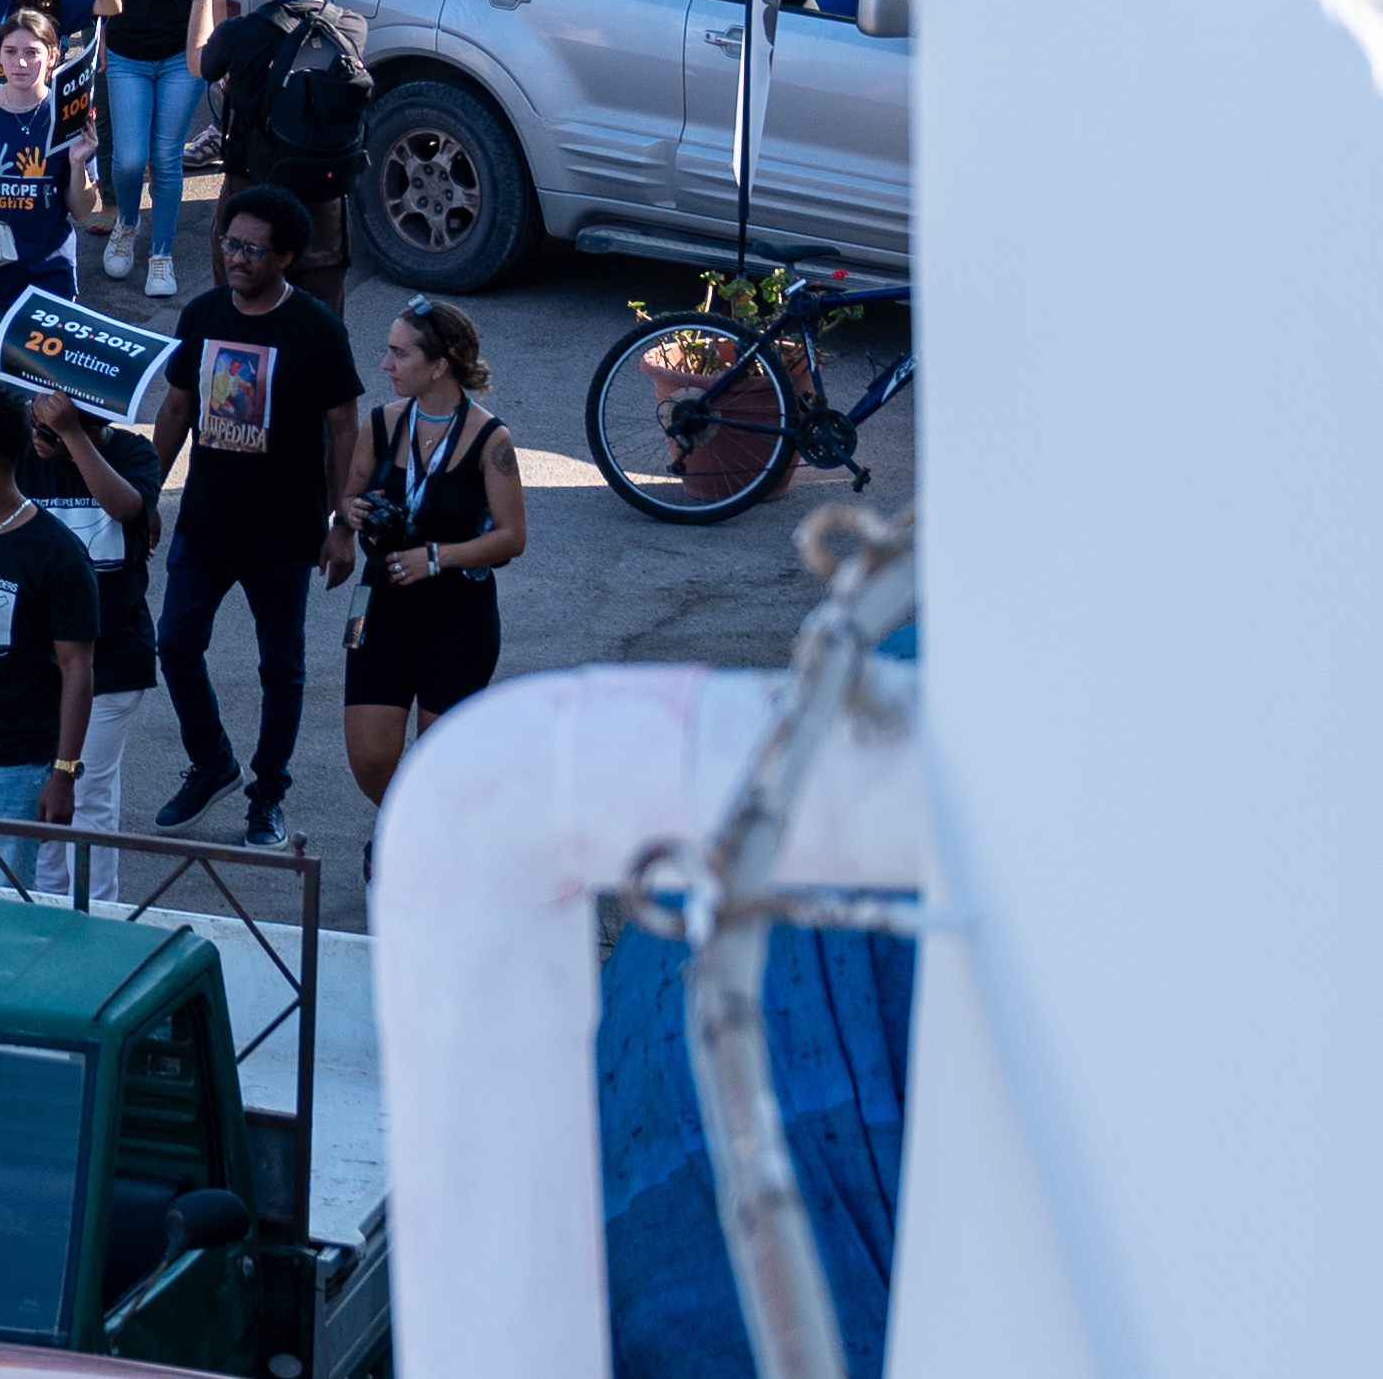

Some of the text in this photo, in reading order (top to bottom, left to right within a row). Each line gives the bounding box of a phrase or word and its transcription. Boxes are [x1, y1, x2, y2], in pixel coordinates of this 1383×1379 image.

[62, 92, 89, 121] 100
[25, 329, 120, 380] 20 vittime
[30, 307, 147, 359] 29.05.2017
